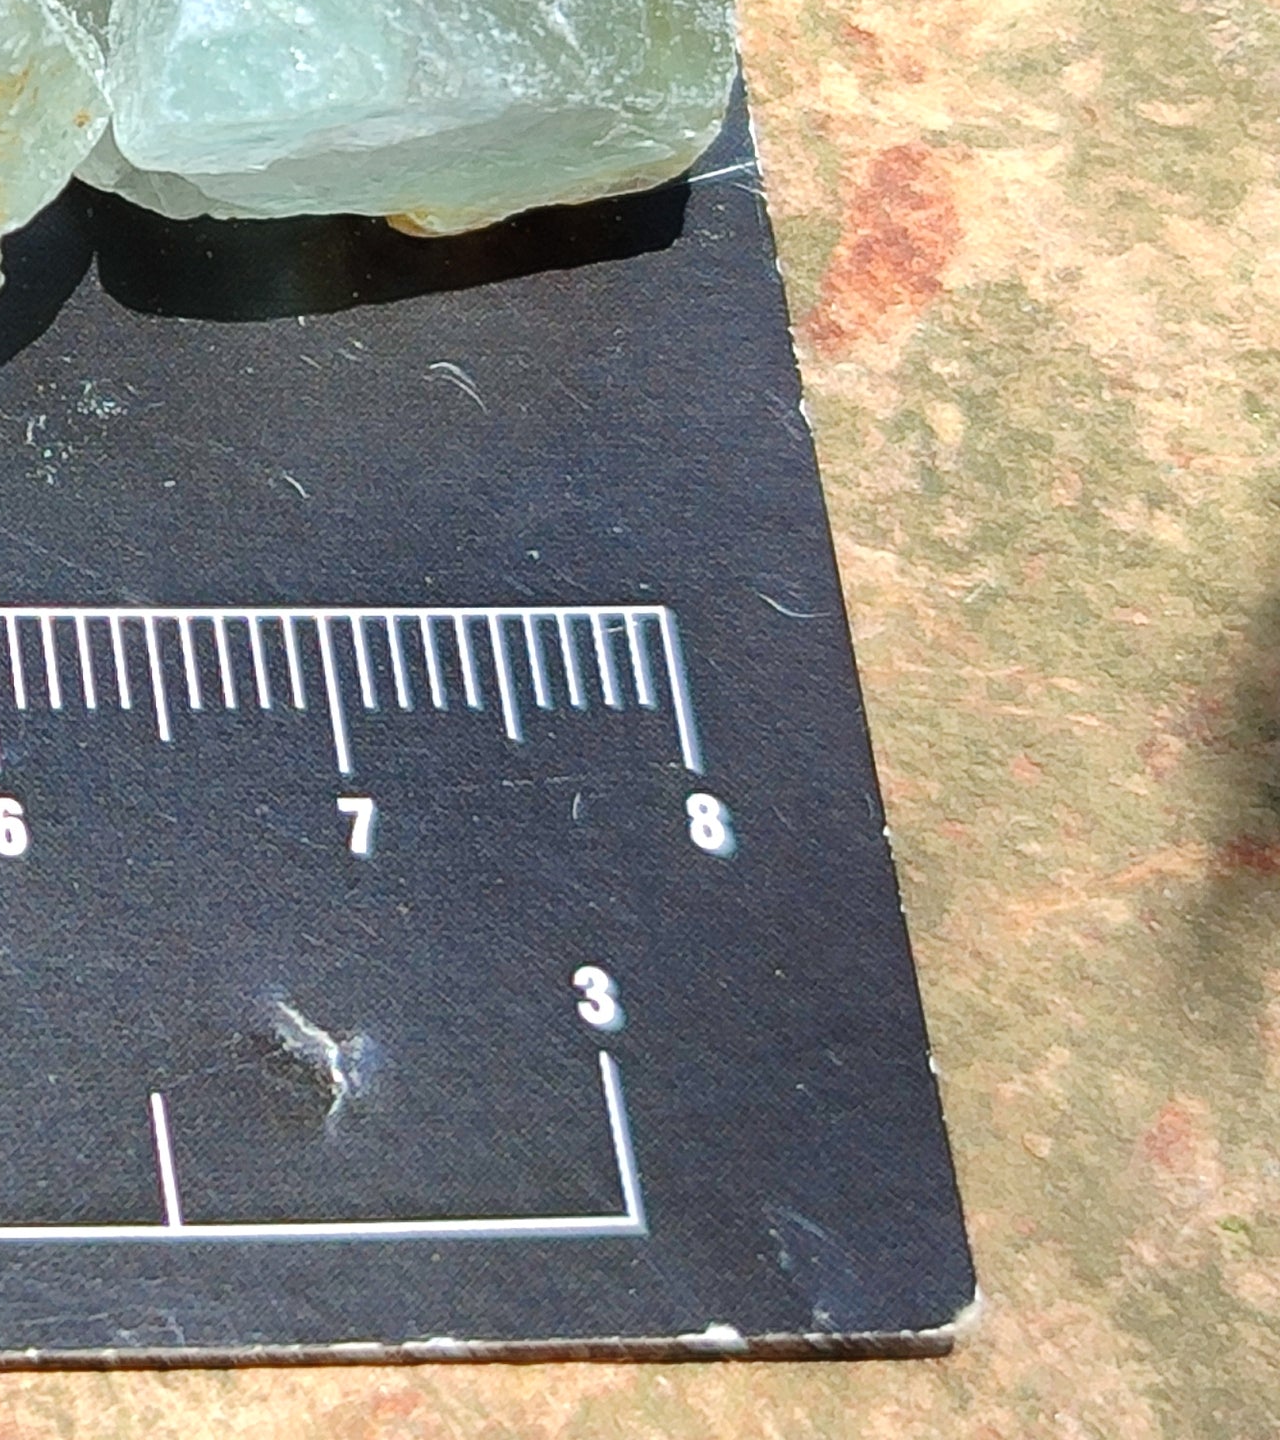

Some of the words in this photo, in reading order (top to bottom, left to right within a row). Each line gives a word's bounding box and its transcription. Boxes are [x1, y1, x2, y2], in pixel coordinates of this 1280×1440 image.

[335, 796, 376, 856] 7
[684, 791, 734, 856] 8
[572, 964, 623, 1032] 3
